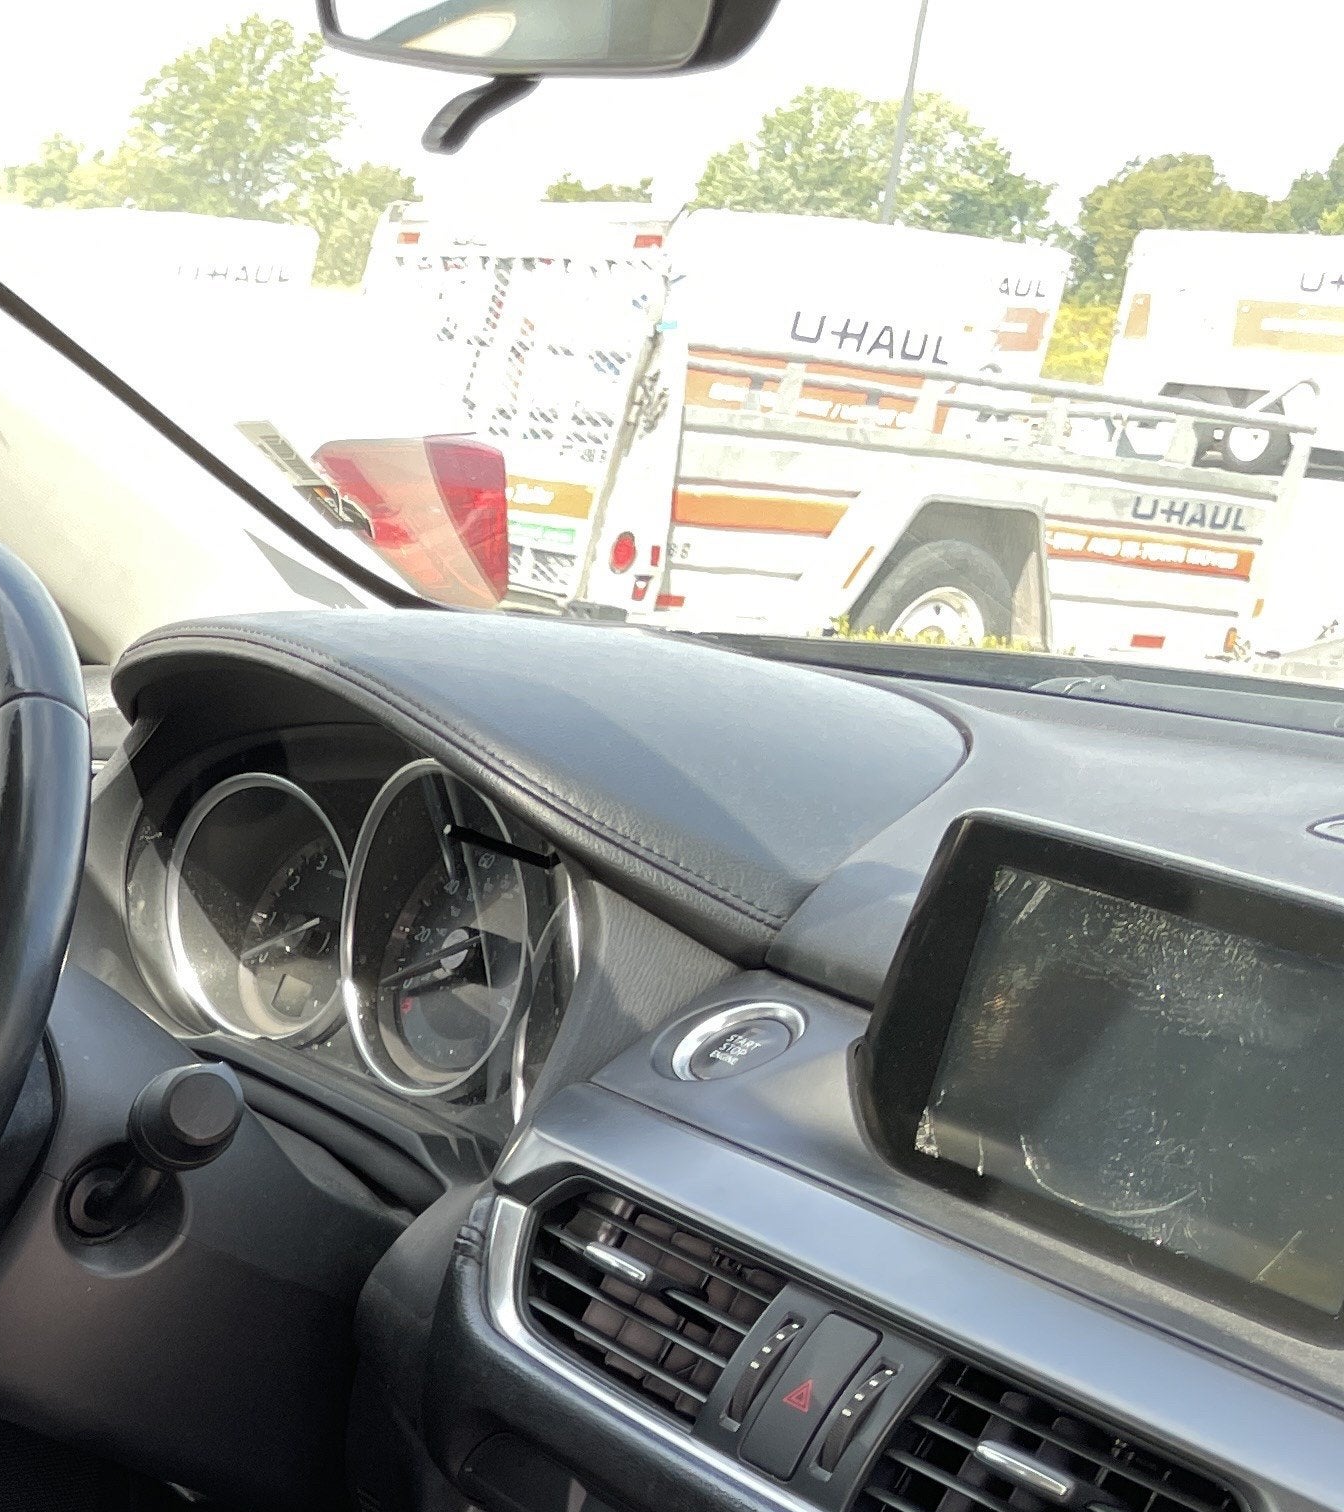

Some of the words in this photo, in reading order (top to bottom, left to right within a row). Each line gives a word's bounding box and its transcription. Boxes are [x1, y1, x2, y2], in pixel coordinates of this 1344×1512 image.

[789, 310, 949, 366] U-HAUL
[1131, 496, 1246, 532] U-HAUL
[288, 875, 301, 891] 2
[718, 1042, 748, 1057] STOP
[725, 1033, 762, 1051] START
